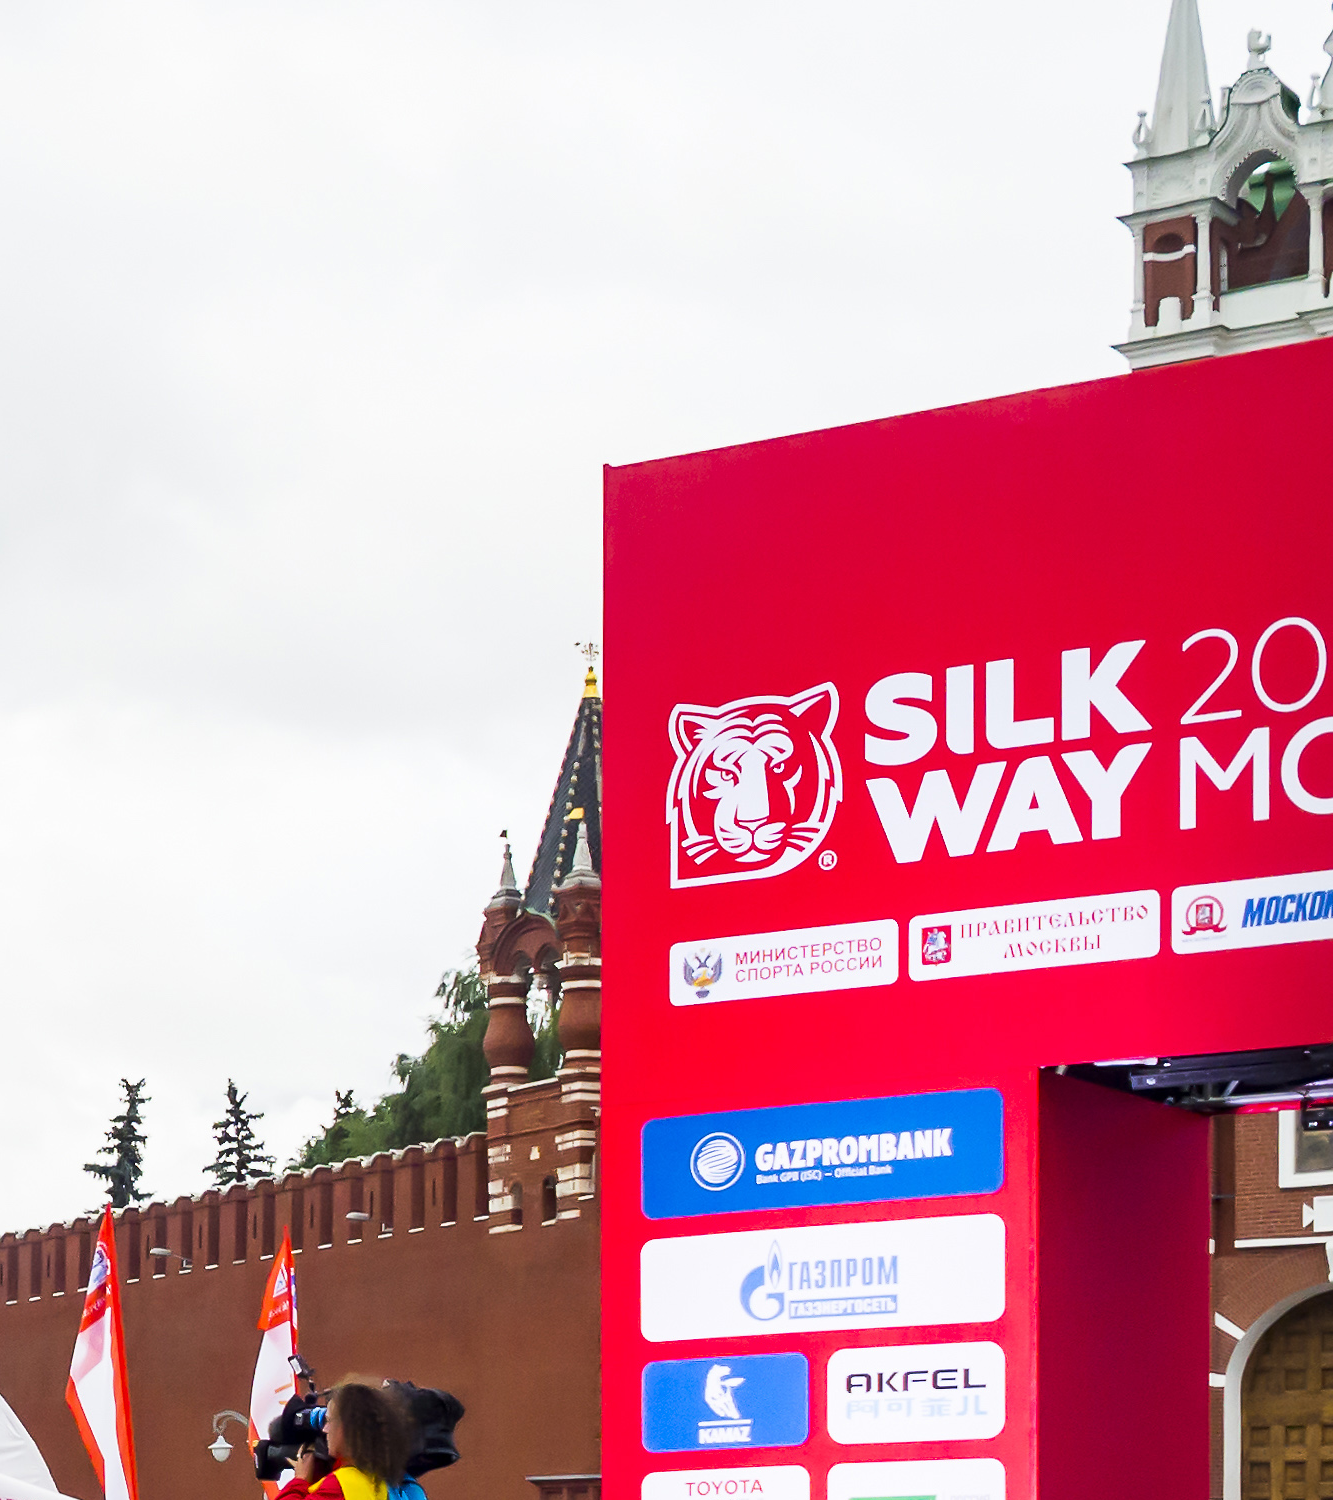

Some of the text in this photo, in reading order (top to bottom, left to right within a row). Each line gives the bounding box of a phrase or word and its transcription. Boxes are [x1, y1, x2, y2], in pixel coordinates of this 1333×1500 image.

[865, 617, 1327, 766] SILK 20
[866, 743, 1153, 863] WAY
[960, 904, 1149, 939] ПРАВИТЕЛЬСТВО
[734, 937, 883, 966] МИНИСТЕРСТВО
[1004, 933, 1103, 960] МОСКВЫ
[735, 955, 884, 984] СПОРТА РОССИИ
[755, 1127, 953, 1171] GAZPROMBANK
[756, 1173, 779, 1184] Bank
[868, 1164, 893, 1176] Bank
[788, 1255, 898, 1290] ГАЗПРОМ
[846, 1368, 987, 1393] AKFEL
[698, 1425, 752, 1444] KAMAZ
[685, 1479, 764, 1497] TOYOTA
